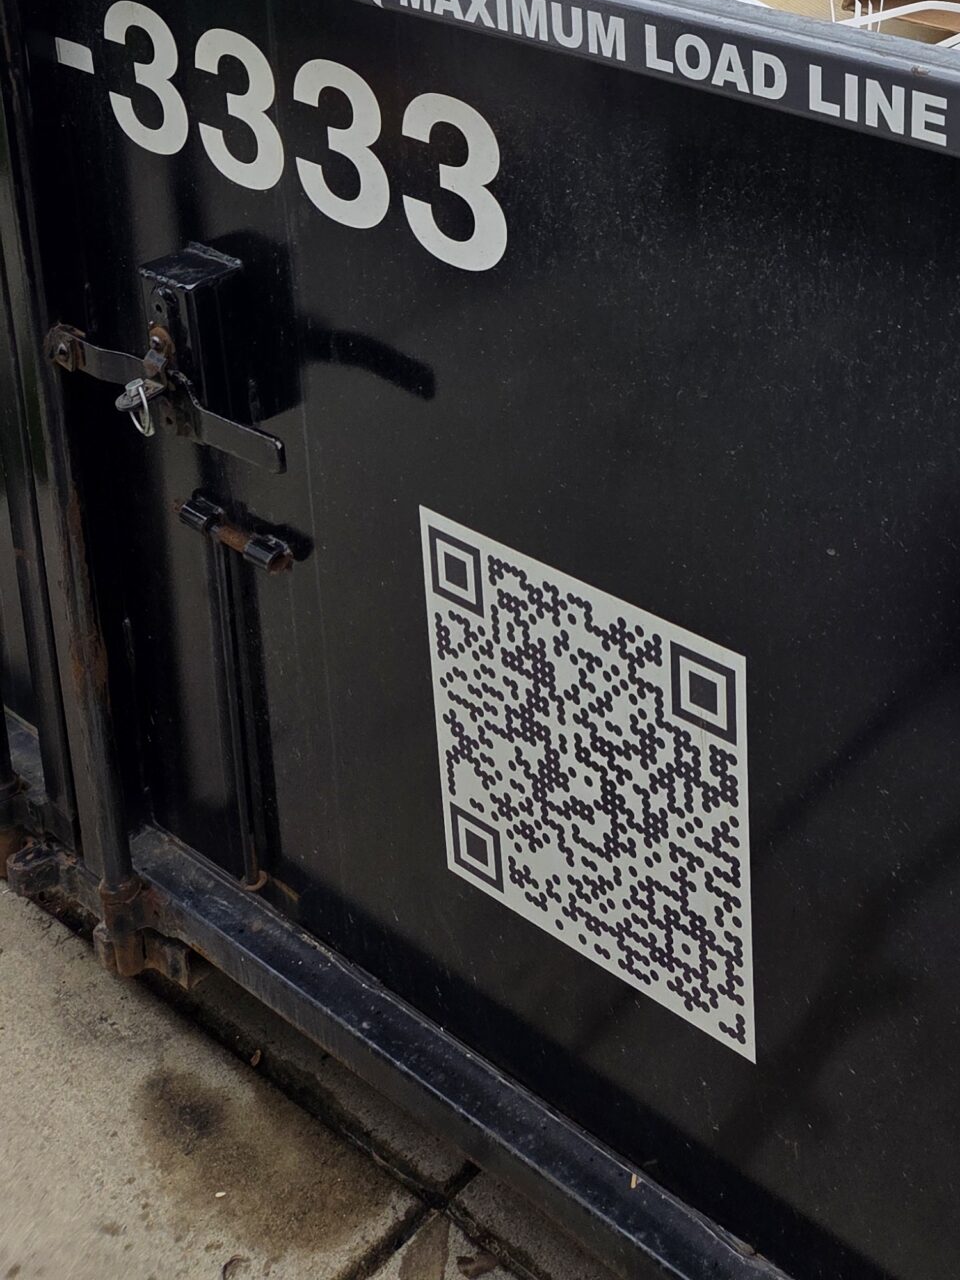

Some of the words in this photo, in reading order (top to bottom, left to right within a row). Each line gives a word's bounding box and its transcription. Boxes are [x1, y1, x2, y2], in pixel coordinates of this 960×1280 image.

[55, 0, 508, 272] -3333
[644, 23, 788, 102] LOAD
[808, 65, 948, 147] LINE
